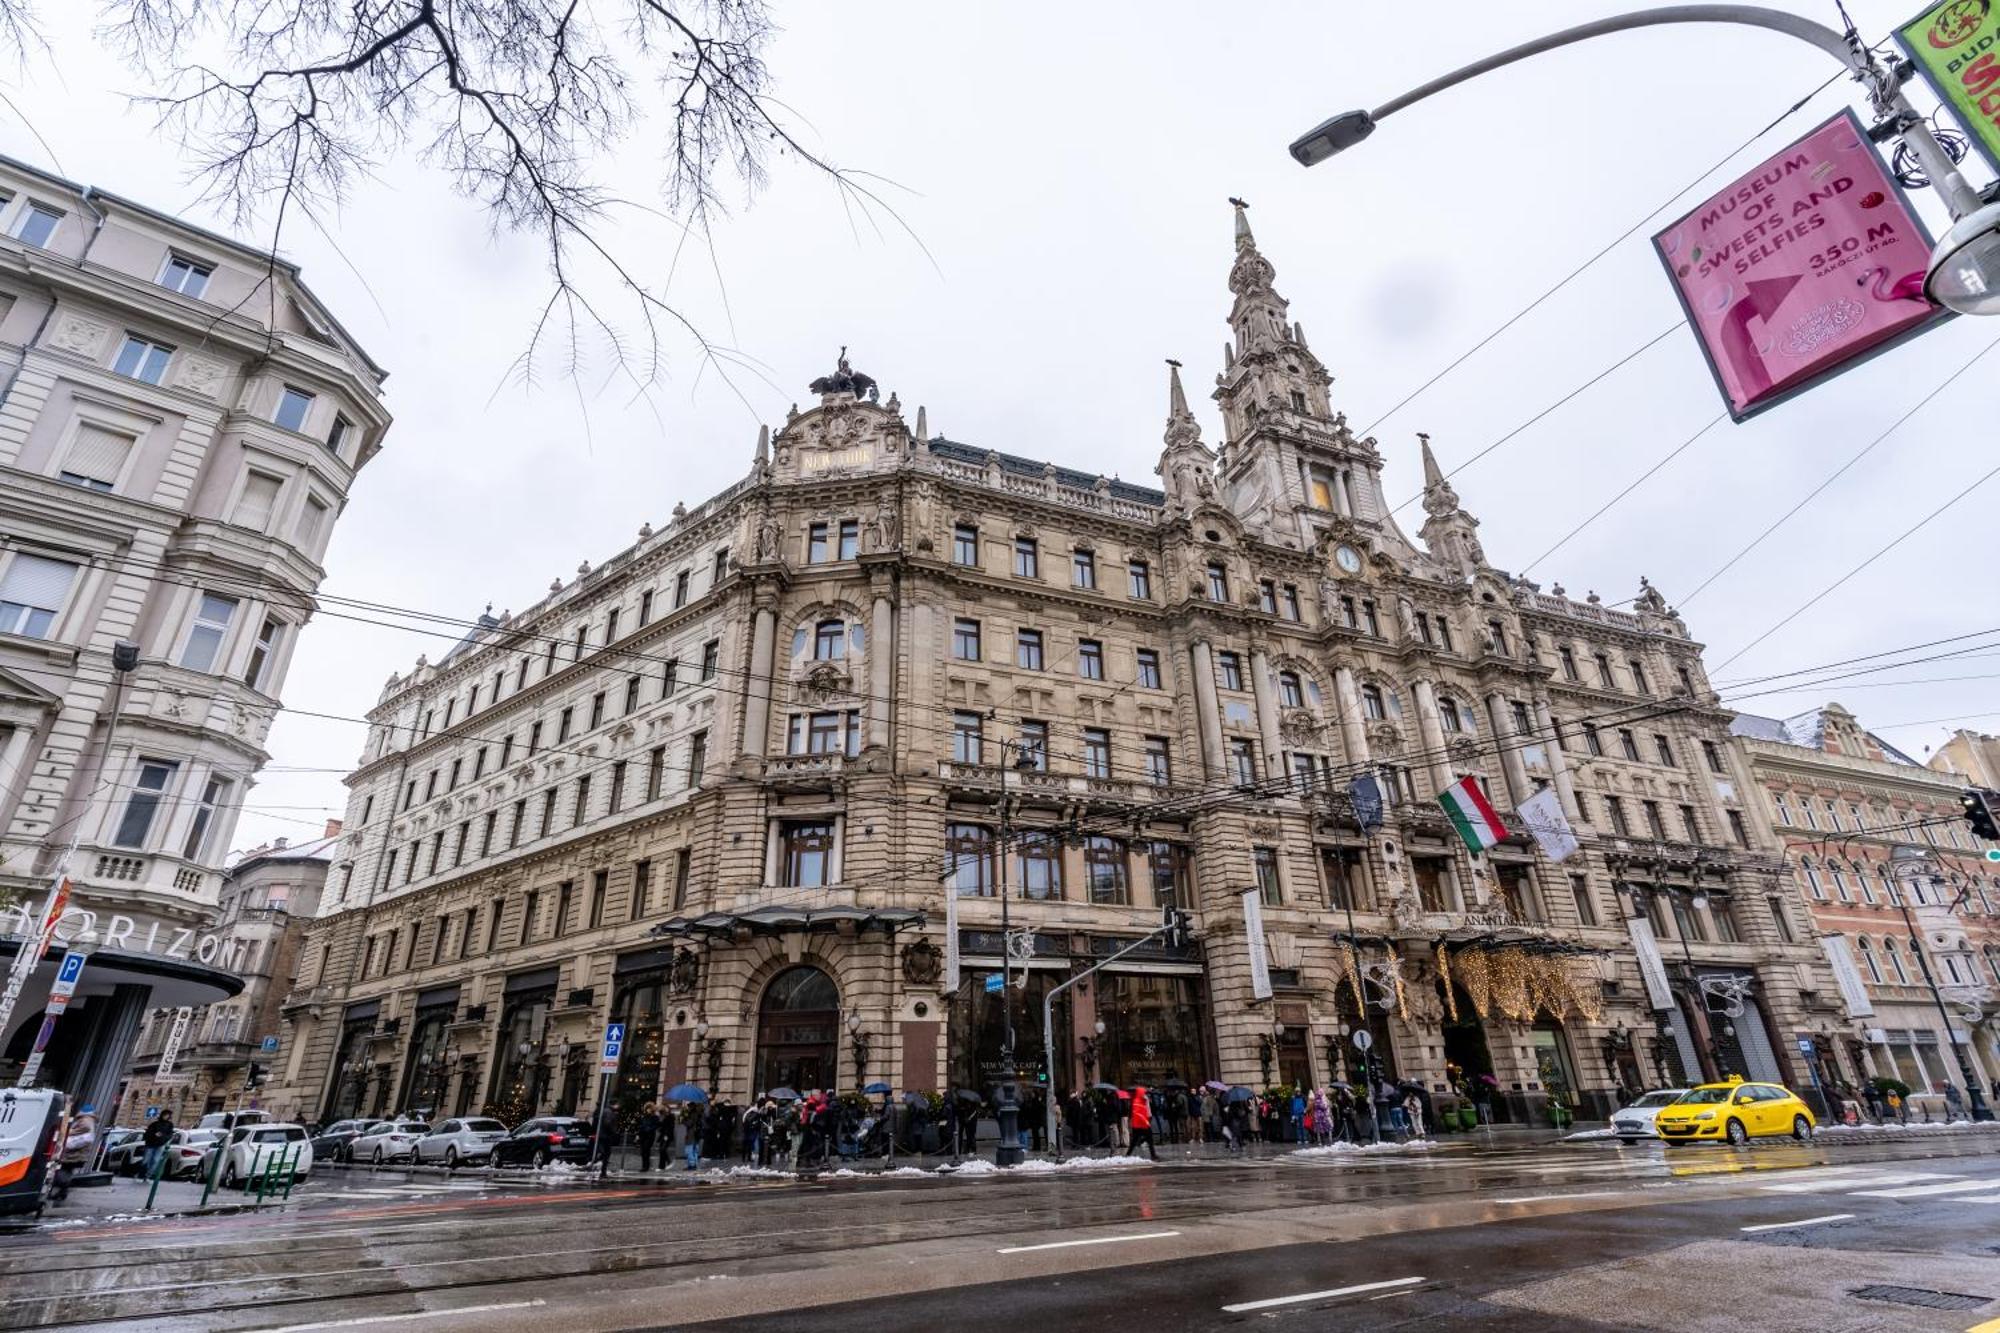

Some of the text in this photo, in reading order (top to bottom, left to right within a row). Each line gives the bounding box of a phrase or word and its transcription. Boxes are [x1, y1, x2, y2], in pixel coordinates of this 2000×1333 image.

[1701, 154, 1810, 231] MUSEUM
[1743, 193, 1776, 221] OF
[1699, 177, 1854, 278] SWEETS AND
[1734, 213, 1825, 275] SELFIES
[1809, 222, 1894, 269] 350 M
[64, 958, 78, 978] P
